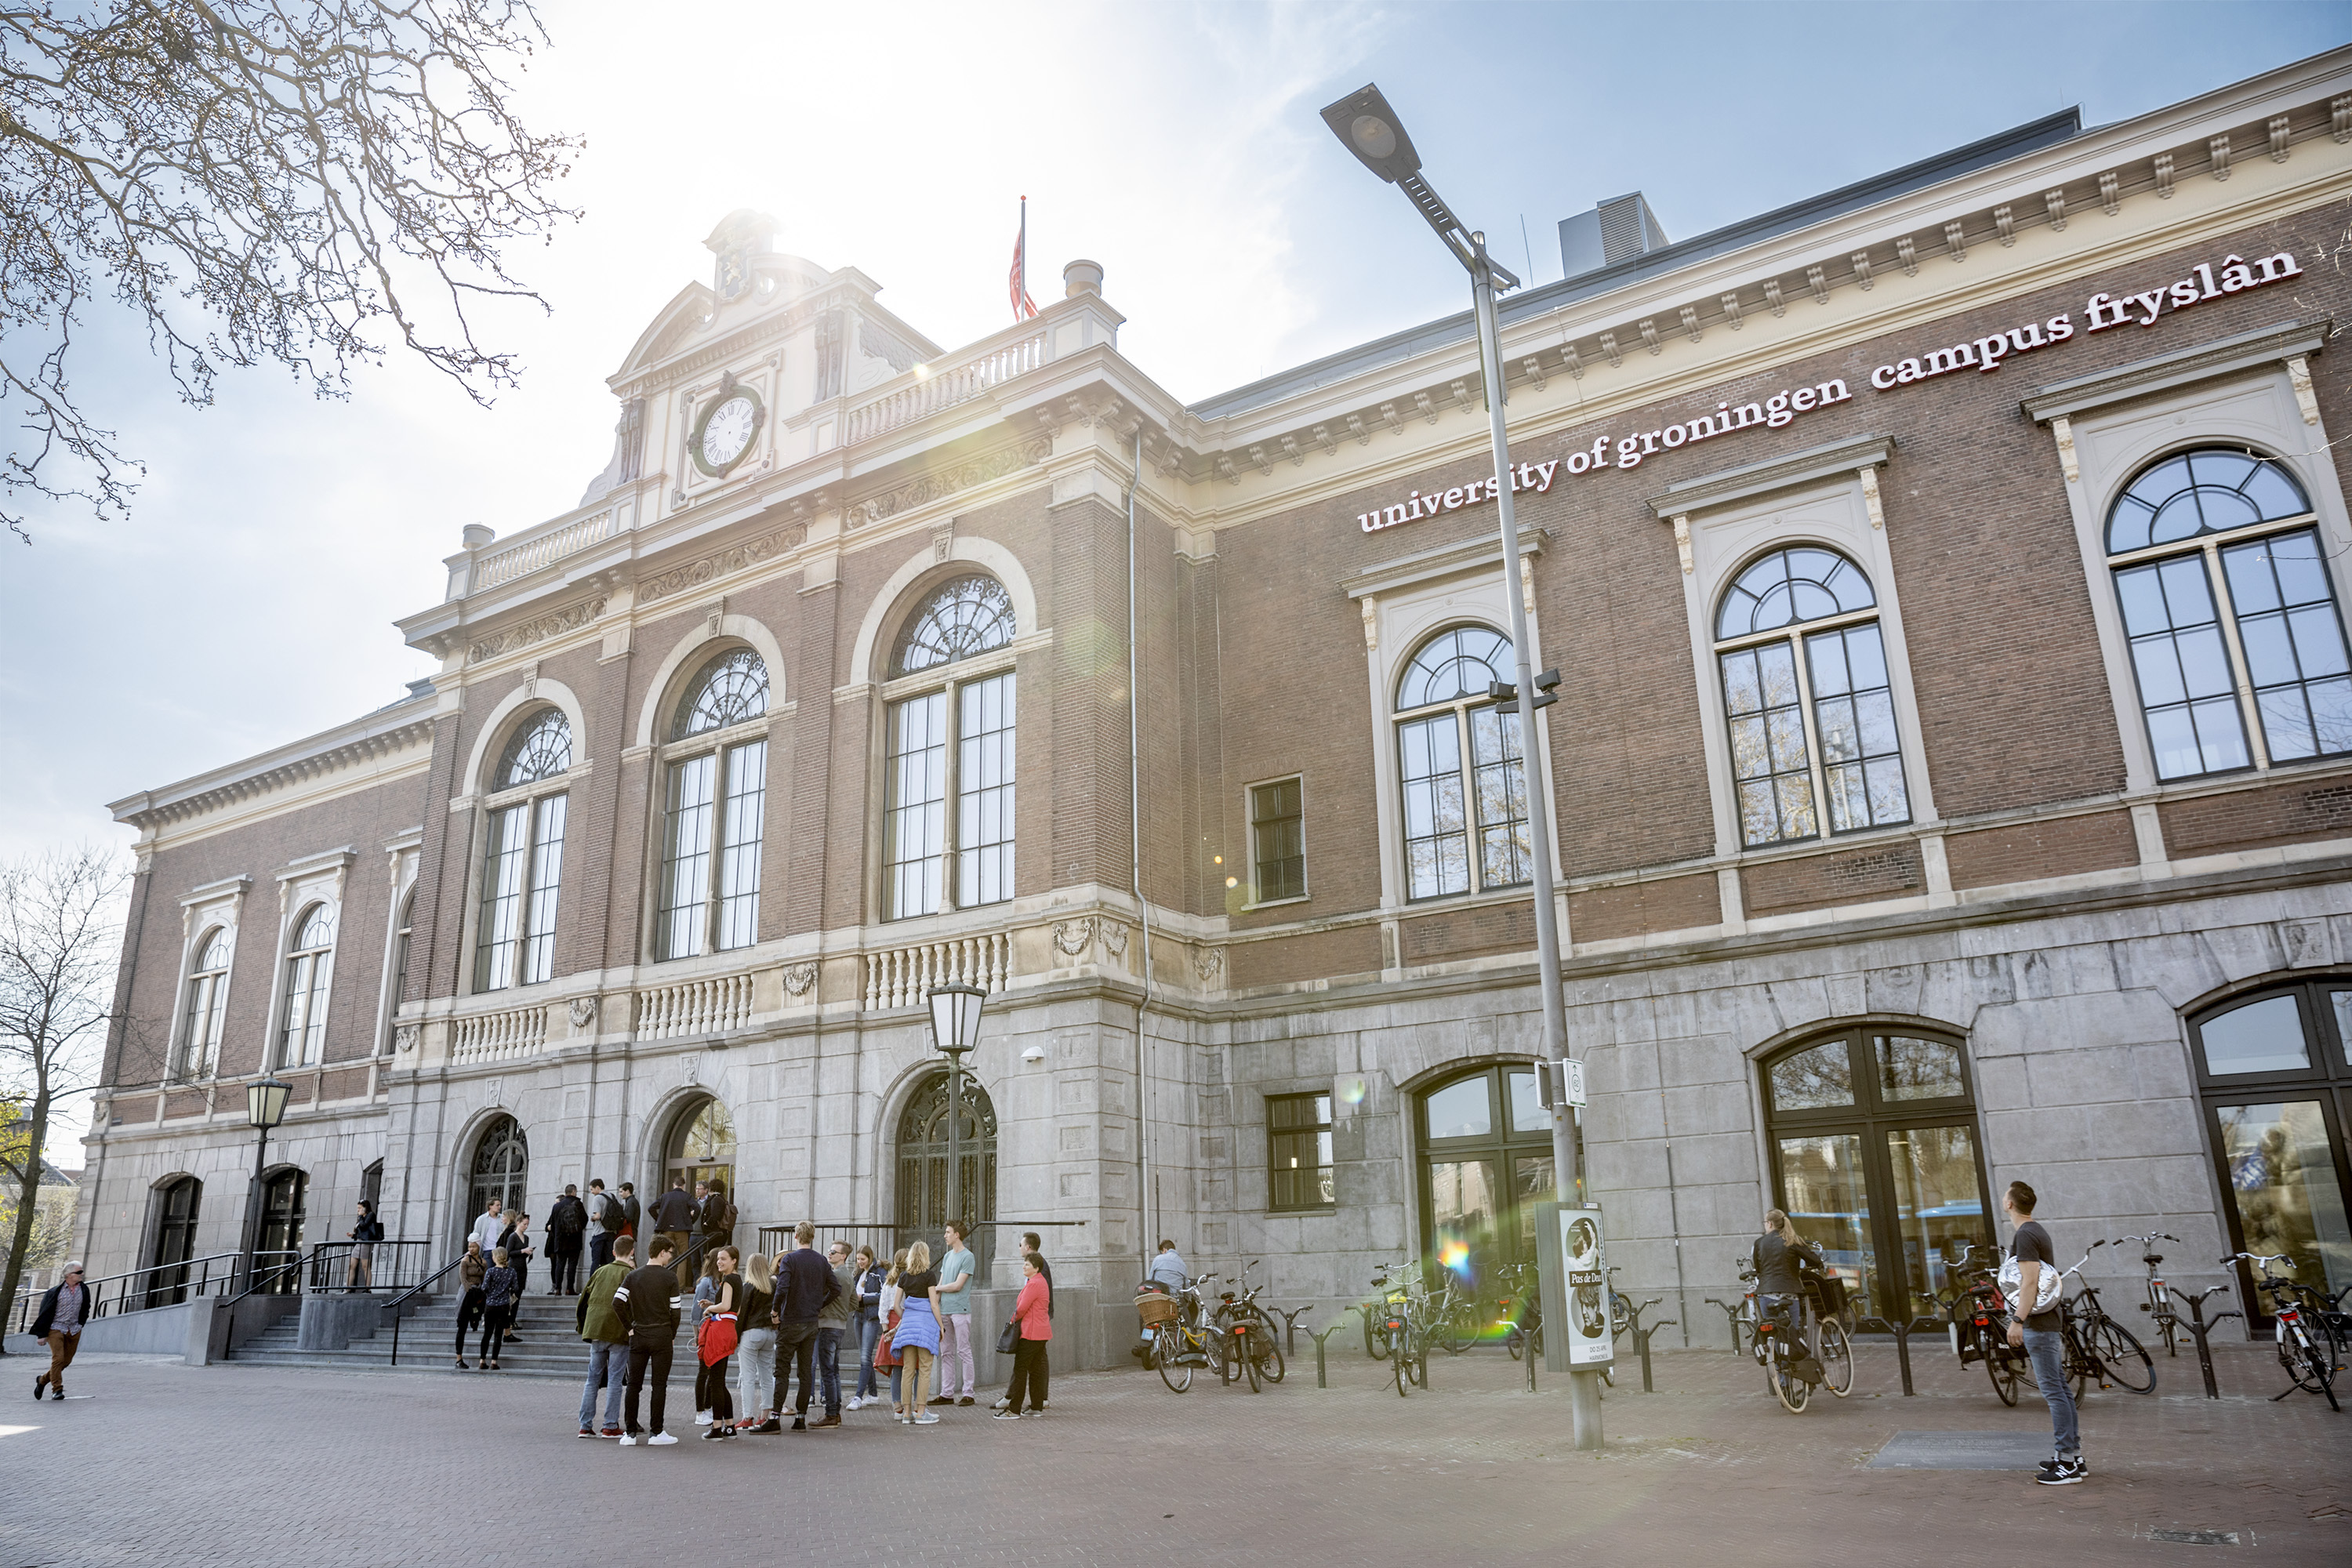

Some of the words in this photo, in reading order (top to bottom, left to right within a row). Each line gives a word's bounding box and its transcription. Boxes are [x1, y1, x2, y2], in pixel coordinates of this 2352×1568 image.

[1357, 459, 1559, 533] university
[1567, 436, 1610, 475] of
[1617, 379, 1853, 470] groningen
[1871, 313, 2074, 390] campus
[2084, 252, 2303, 328] fryslân
[1571, 1273, 1584, 1284] Pas
[1584, 1272, 1591, 1283] de
